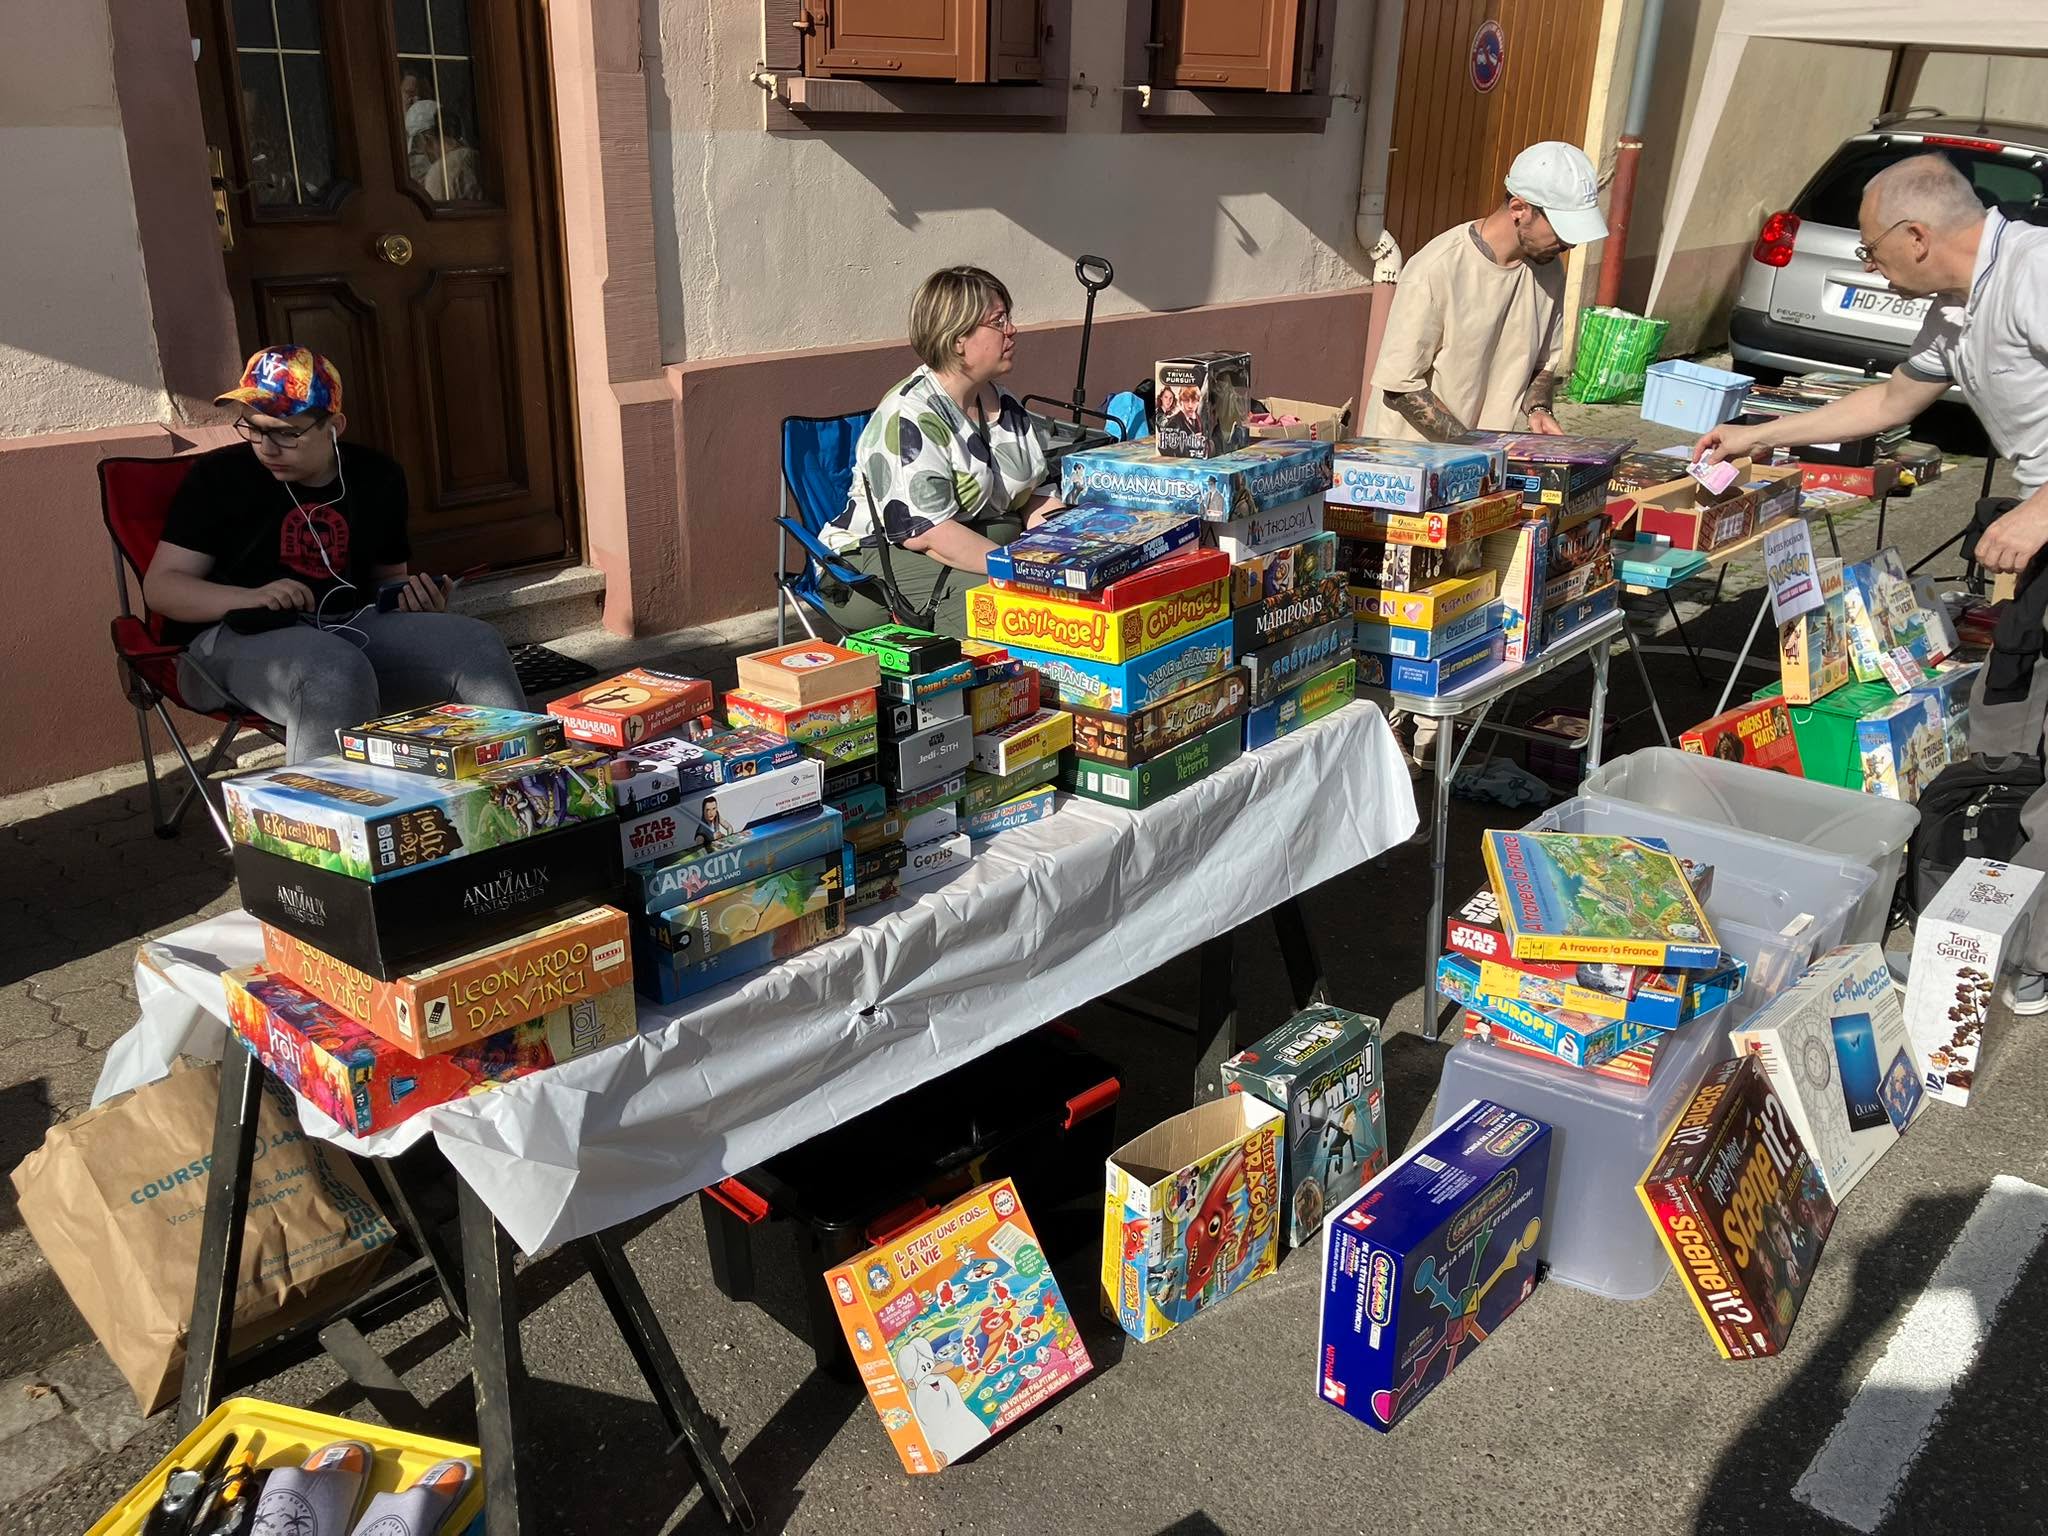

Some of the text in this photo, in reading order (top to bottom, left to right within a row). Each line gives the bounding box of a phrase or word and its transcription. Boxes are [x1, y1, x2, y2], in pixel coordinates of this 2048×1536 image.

[1776, 308, 1816, 321] PEUGEOT
[251, 352, 289, 386] NY
[1251, 462, 1317, 496] COMANAUTES
[1343, 467, 1416, 493] CRYSTAL
[1448, 458, 1488, 484] CRYSTAL
[1091, 470, 1196, 499] COMANAUTES
[1350, 485, 1406, 506] CLANS
[1148, 582, 1219, 638] Challenge!
[1255, 594, 1323, 635] MARIPOSAS
[1003, 609, 1105, 650] Challenge!
[916, 668, 972, 695] DOUBLE SENS
[1737, 708, 1771, 737] CHIENS ET
[1752, 726, 1776, 749] CHATS
[1922, 739, 1944, 760] TRIBUS
[1929, 753, 1946, 770] VENT
[632, 816, 675, 837] STAR
[1003, 813, 1027, 826] QUIZ
[629, 826, 676, 849] WARS
[634, 841, 675, 858] DESTINY
[704, 849, 742, 880] CITY
[914, 847, 953, 869] GOTHS
[1503, 835, 1520, 869] France
[463, 865, 551, 911] ANIMAUX
[1517, 881, 1541, 917] travers
[277, 885, 328, 919] ANIMAUX
[1460, 890, 1494, 921] STAR
[1452, 926, 1494, 943] STAR
[1525, 917, 1544, 932] A
[1450, 934, 1497, 955] WARS
[1560, 943, 1660, 958] A travers la France
[1670, 946, 1714, 956] Ravensburger
[1937, 942, 1986, 965] Garden
[1949, 931, 1980, 953] Tang
[450, 942, 590, 1008] LEONARDO
[303, 957, 372, 1022] DA VINCI
[466, 970, 589, 1032] DA VINCI
[1670, 1083, 1727, 1147] scene it?
[1262, 1128, 1280, 1206] ATTENTION
[1242, 1131, 1276, 1241] DRAGON
[1722, 1093, 1798, 1269] scene it?
[894, 1251, 905, 1264] IL
[907, 1233, 934, 1257] ETAIT
[936, 1220, 958, 1240] UNE
[1361, 1242, 1369, 1254] DE
[900, 1245, 941, 1280] LA VIE
[1360, 1254, 1368, 1263] LA
[1669, 1214, 1753, 1326] scene it?
[896, 1292, 913, 1309] 500
[1356, 1293, 1364, 1305] DU
[1357, 1283, 1365, 1293] ET
[1325, 1343, 1335, 1379] NATHAN
[1009, 1389, 1029, 1406] VOYAGE
